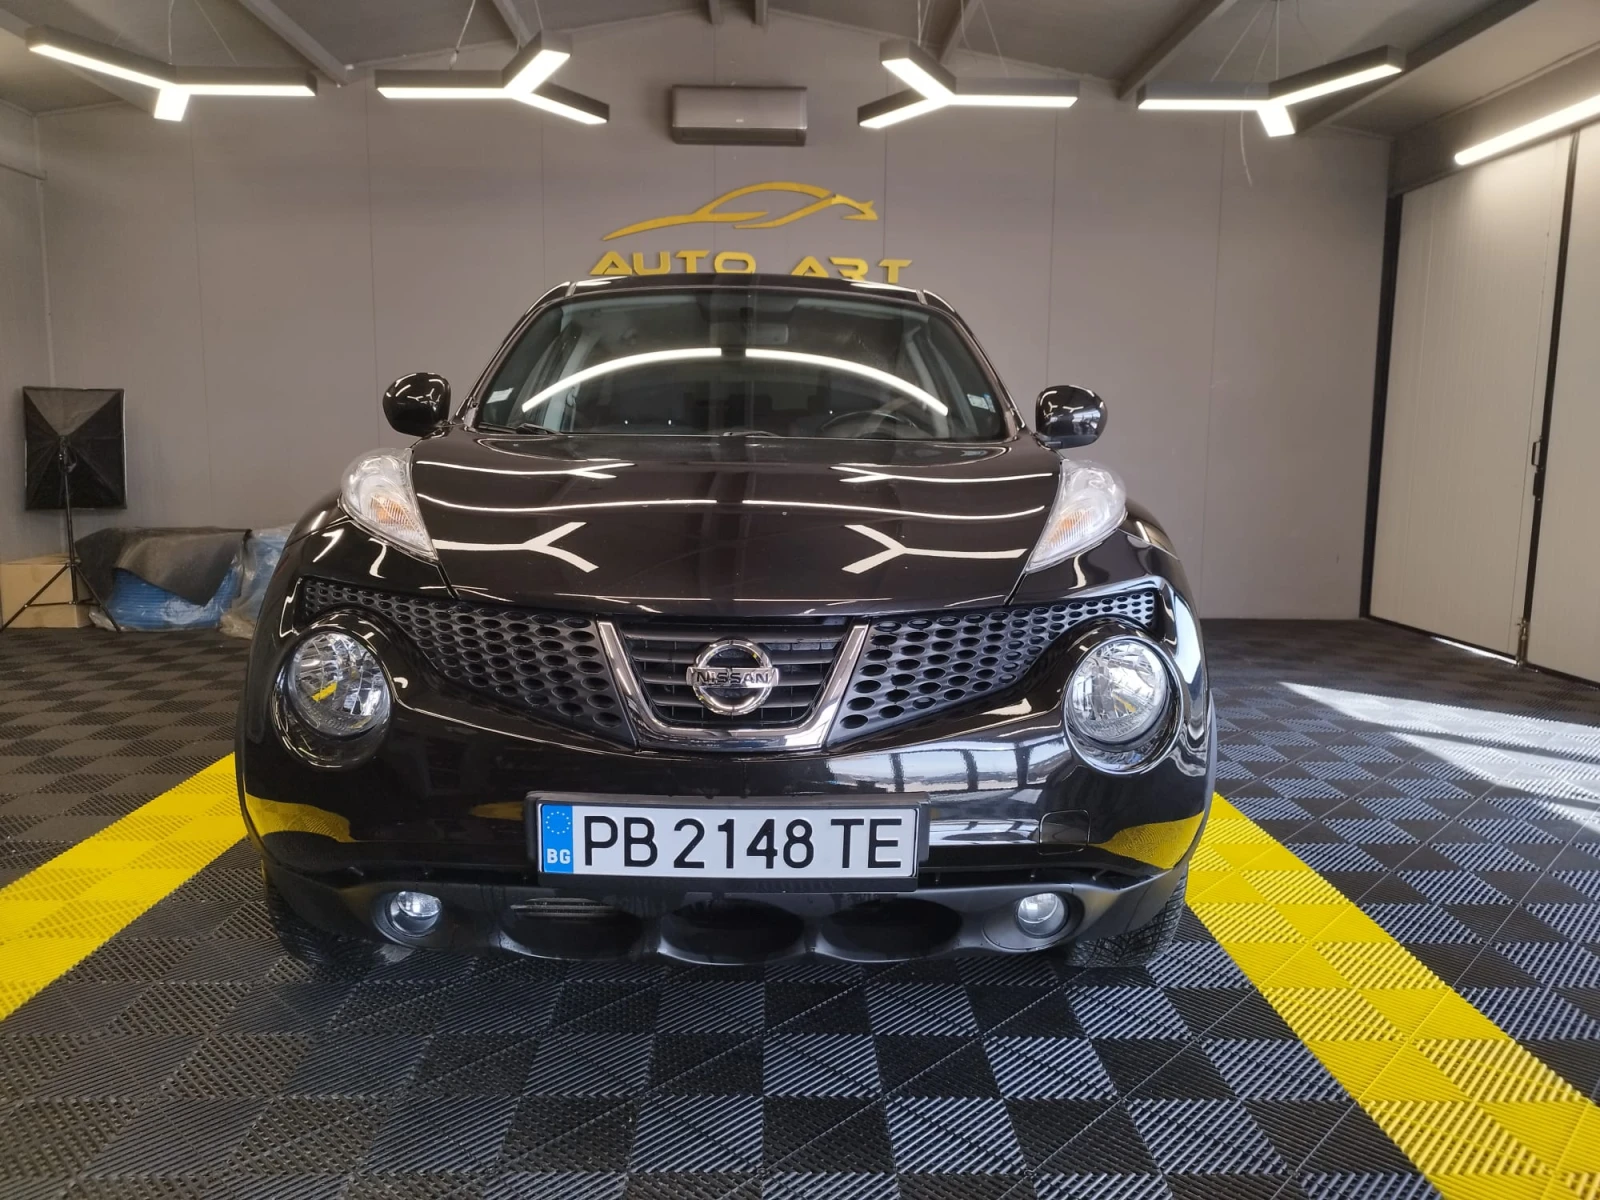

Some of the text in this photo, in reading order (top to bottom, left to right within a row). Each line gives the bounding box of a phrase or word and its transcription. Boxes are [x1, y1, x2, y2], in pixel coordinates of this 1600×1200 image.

[589, 251, 913, 283] AUTO ART
[696, 671, 769, 685] NISSAN
[583, 815, 902, 869] PB 2148 TE
[546, 849, 570, 864] BG
